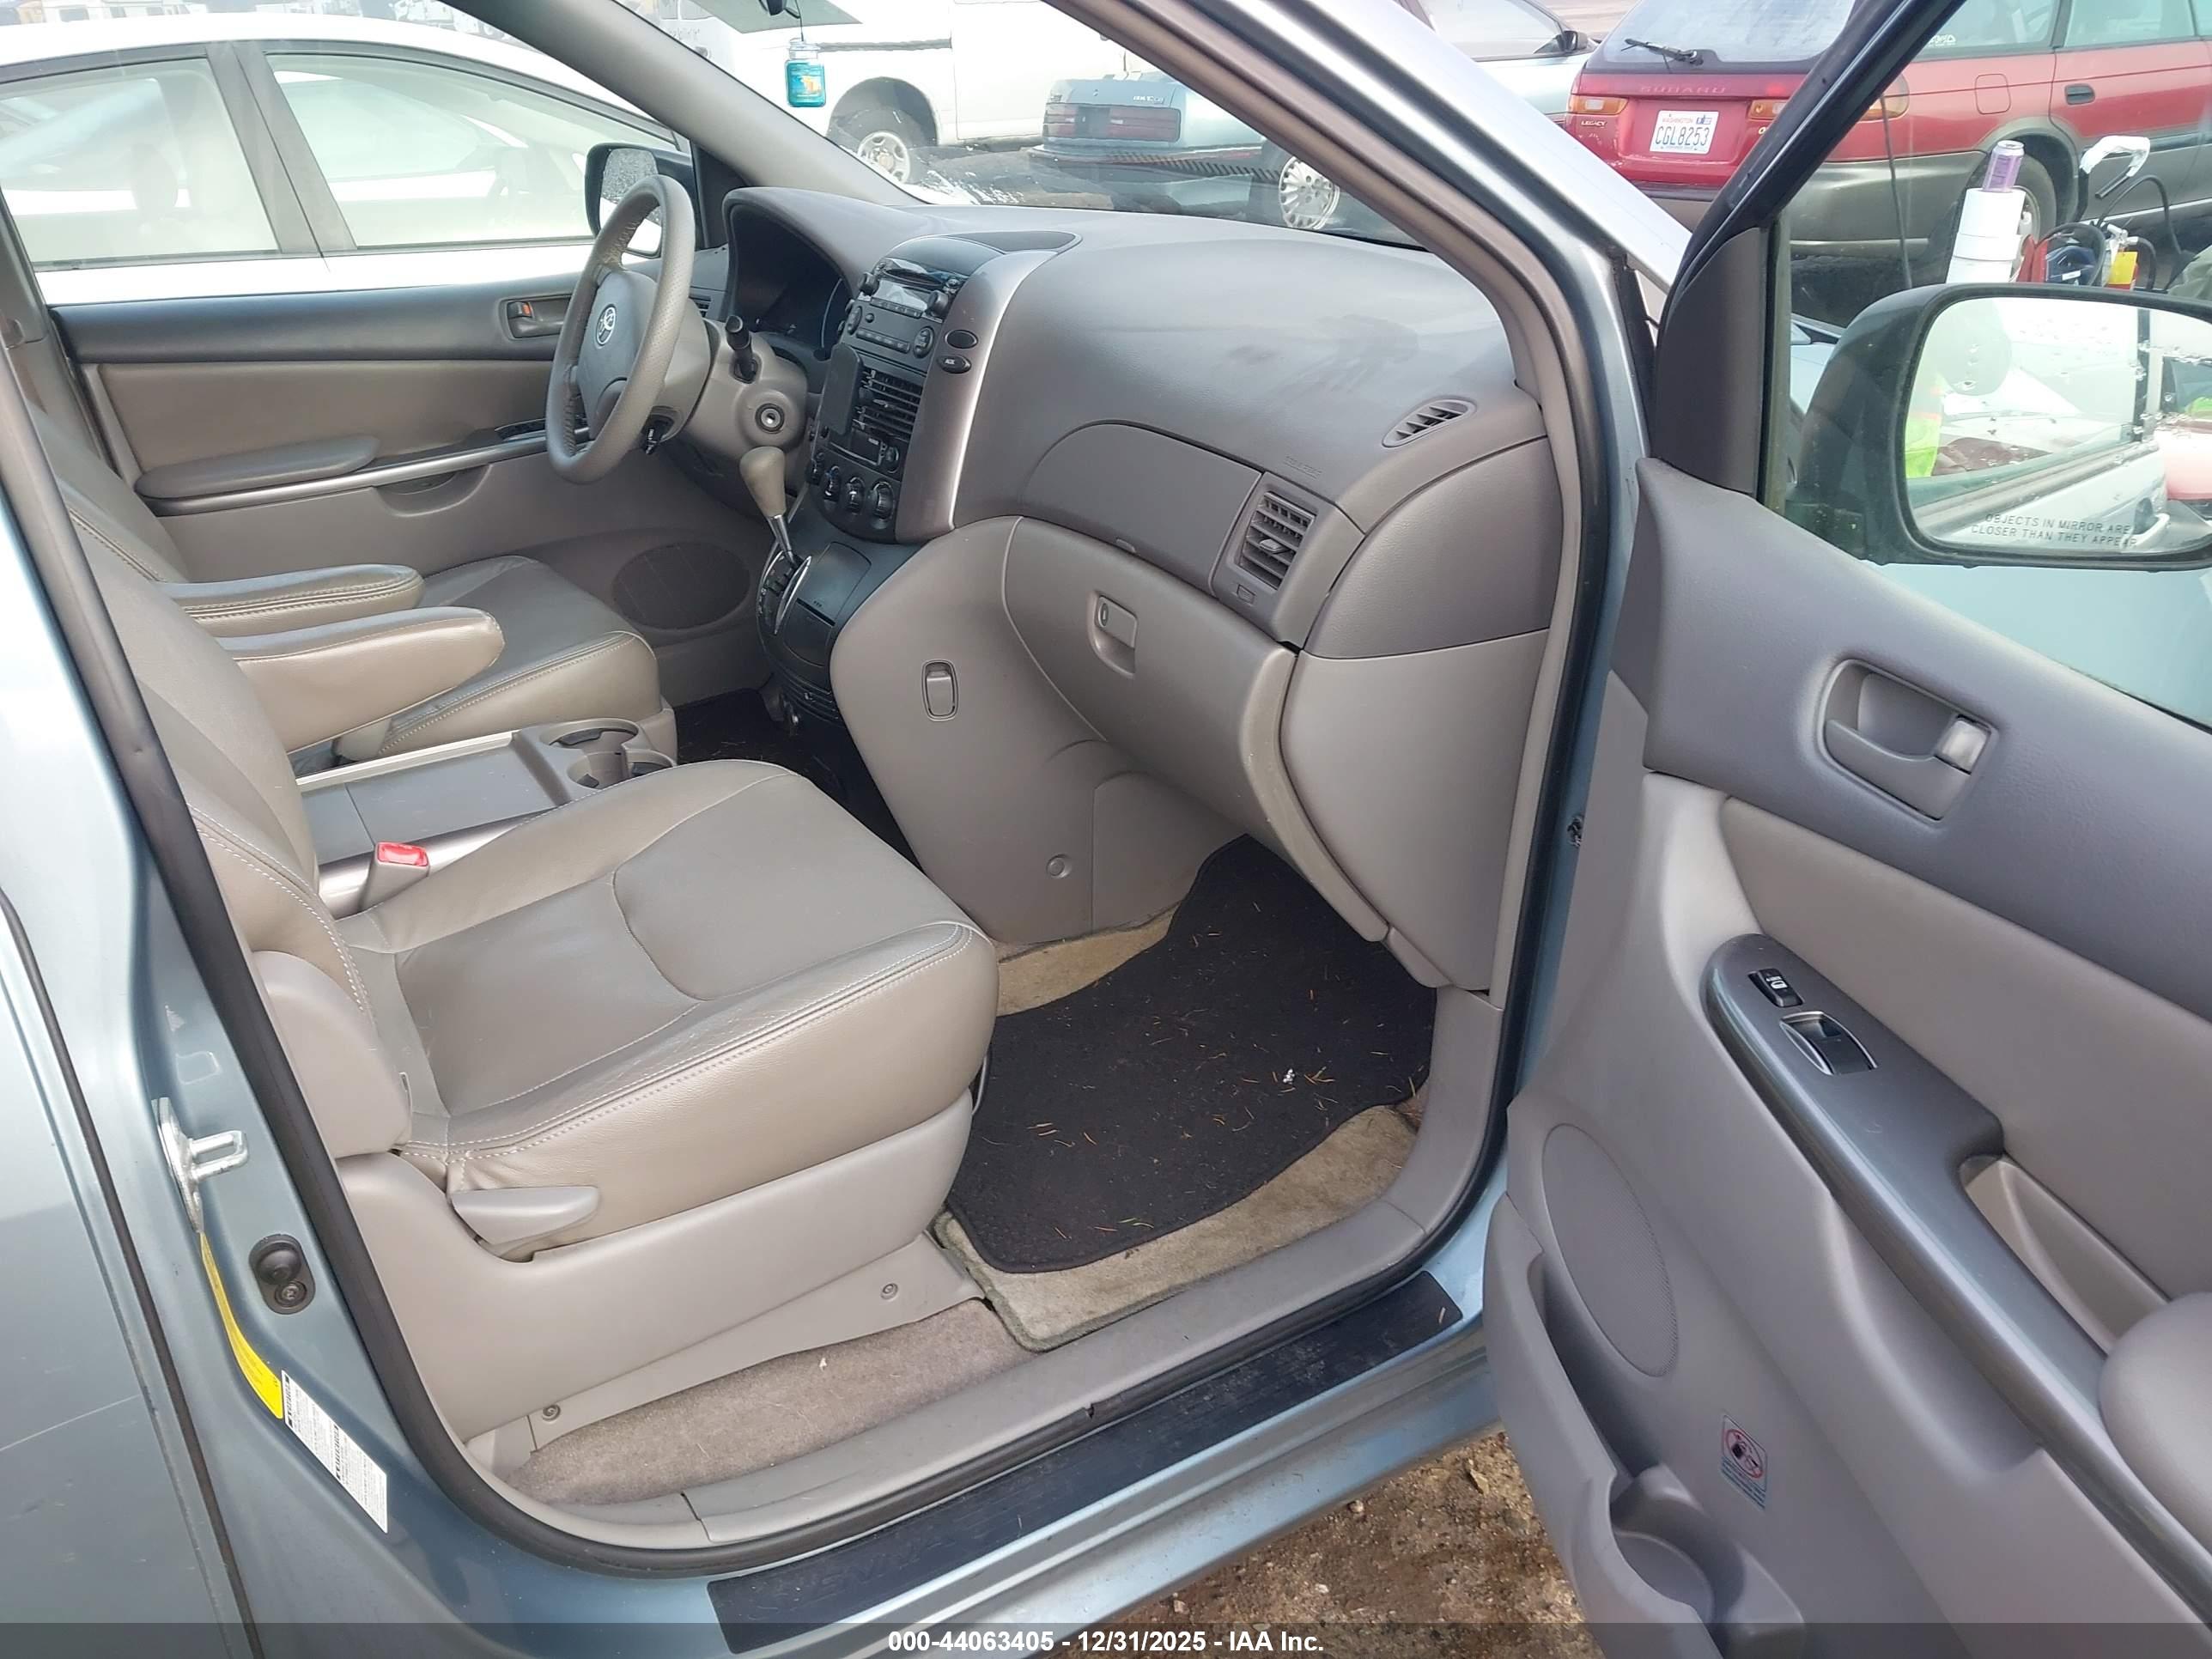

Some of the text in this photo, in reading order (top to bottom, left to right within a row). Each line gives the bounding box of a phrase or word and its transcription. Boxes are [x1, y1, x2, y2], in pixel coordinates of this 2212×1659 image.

[1655, 125, 1710, 146] CGL8253
[1985, 514, 2131, 534] OBJECTS IN MIRROR ARE
[1971, 525, 2137, 548] CLOSER THAN THEY APPEAR
